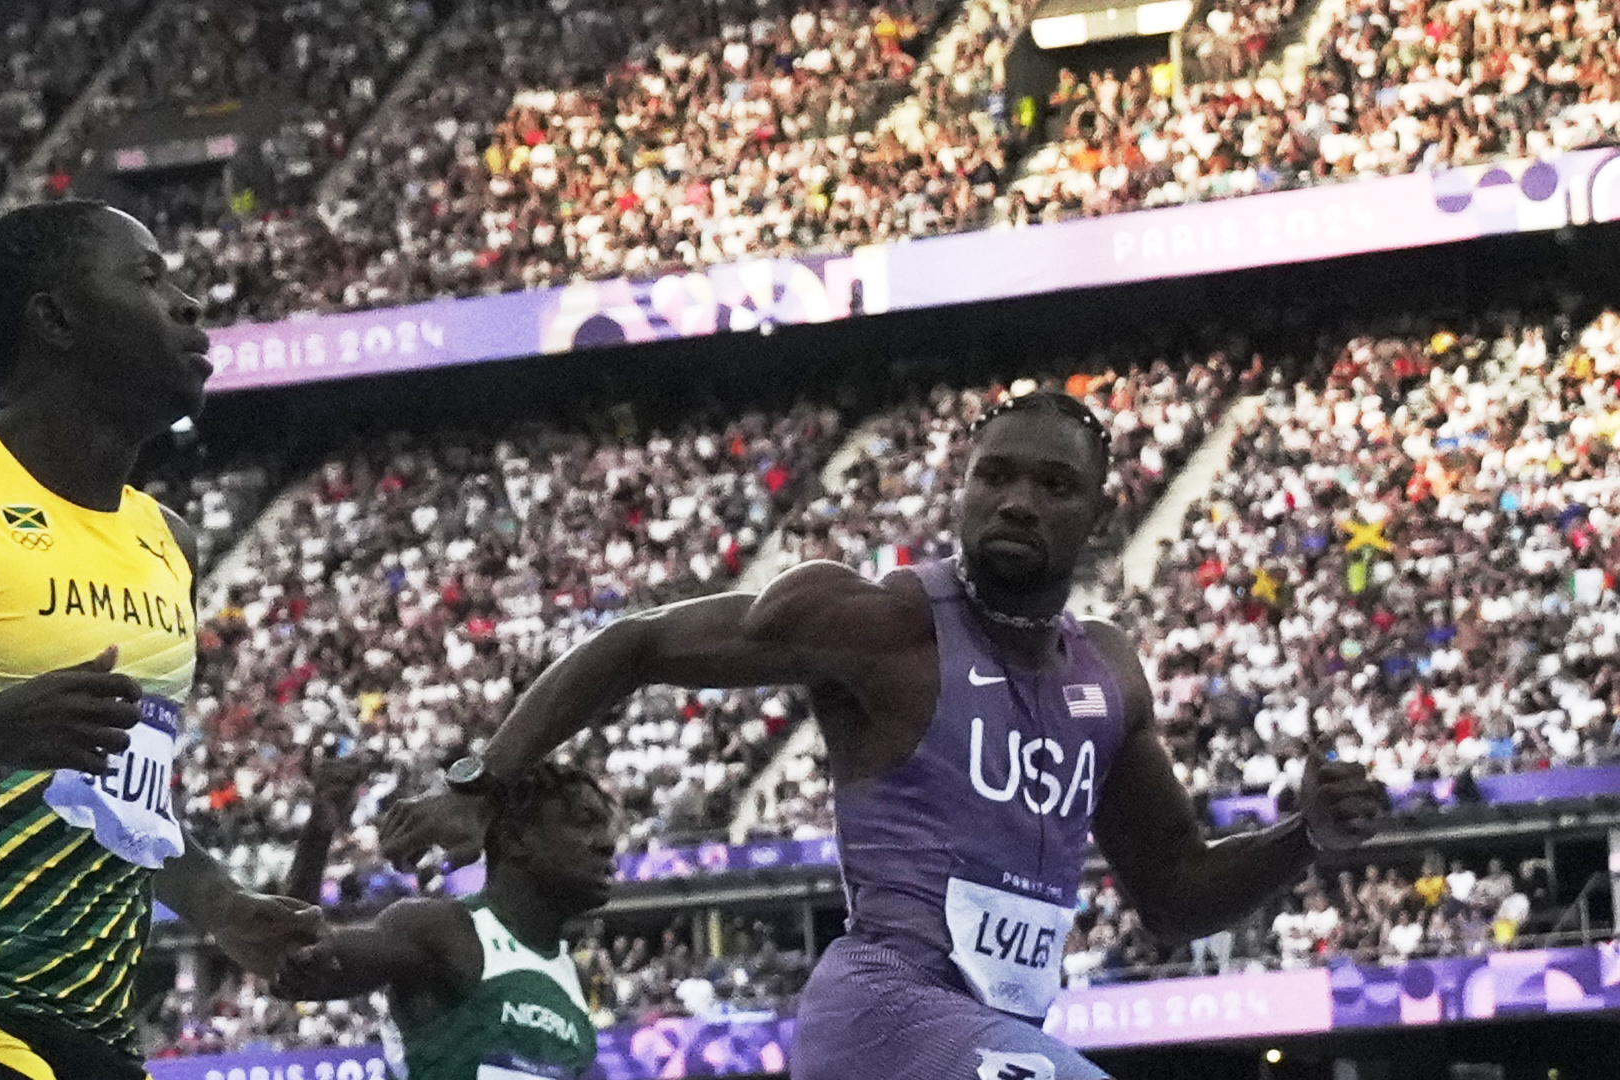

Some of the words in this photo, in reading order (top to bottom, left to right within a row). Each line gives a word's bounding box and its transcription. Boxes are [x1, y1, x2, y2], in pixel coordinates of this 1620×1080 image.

[1112, 217, 1240, 263] PARIS
[1256, 202, 1374, 247] 2024
[212, 333, 326, 375] PARIS
[339, 320, 444, 363] 2024
[38, 577, 187, 638] JAMAICA
[969, 717, 1095, 818] USA
[1042, 998, 1153, 1035] PARIS
[1165, 989, 1270, 1027] 2024
